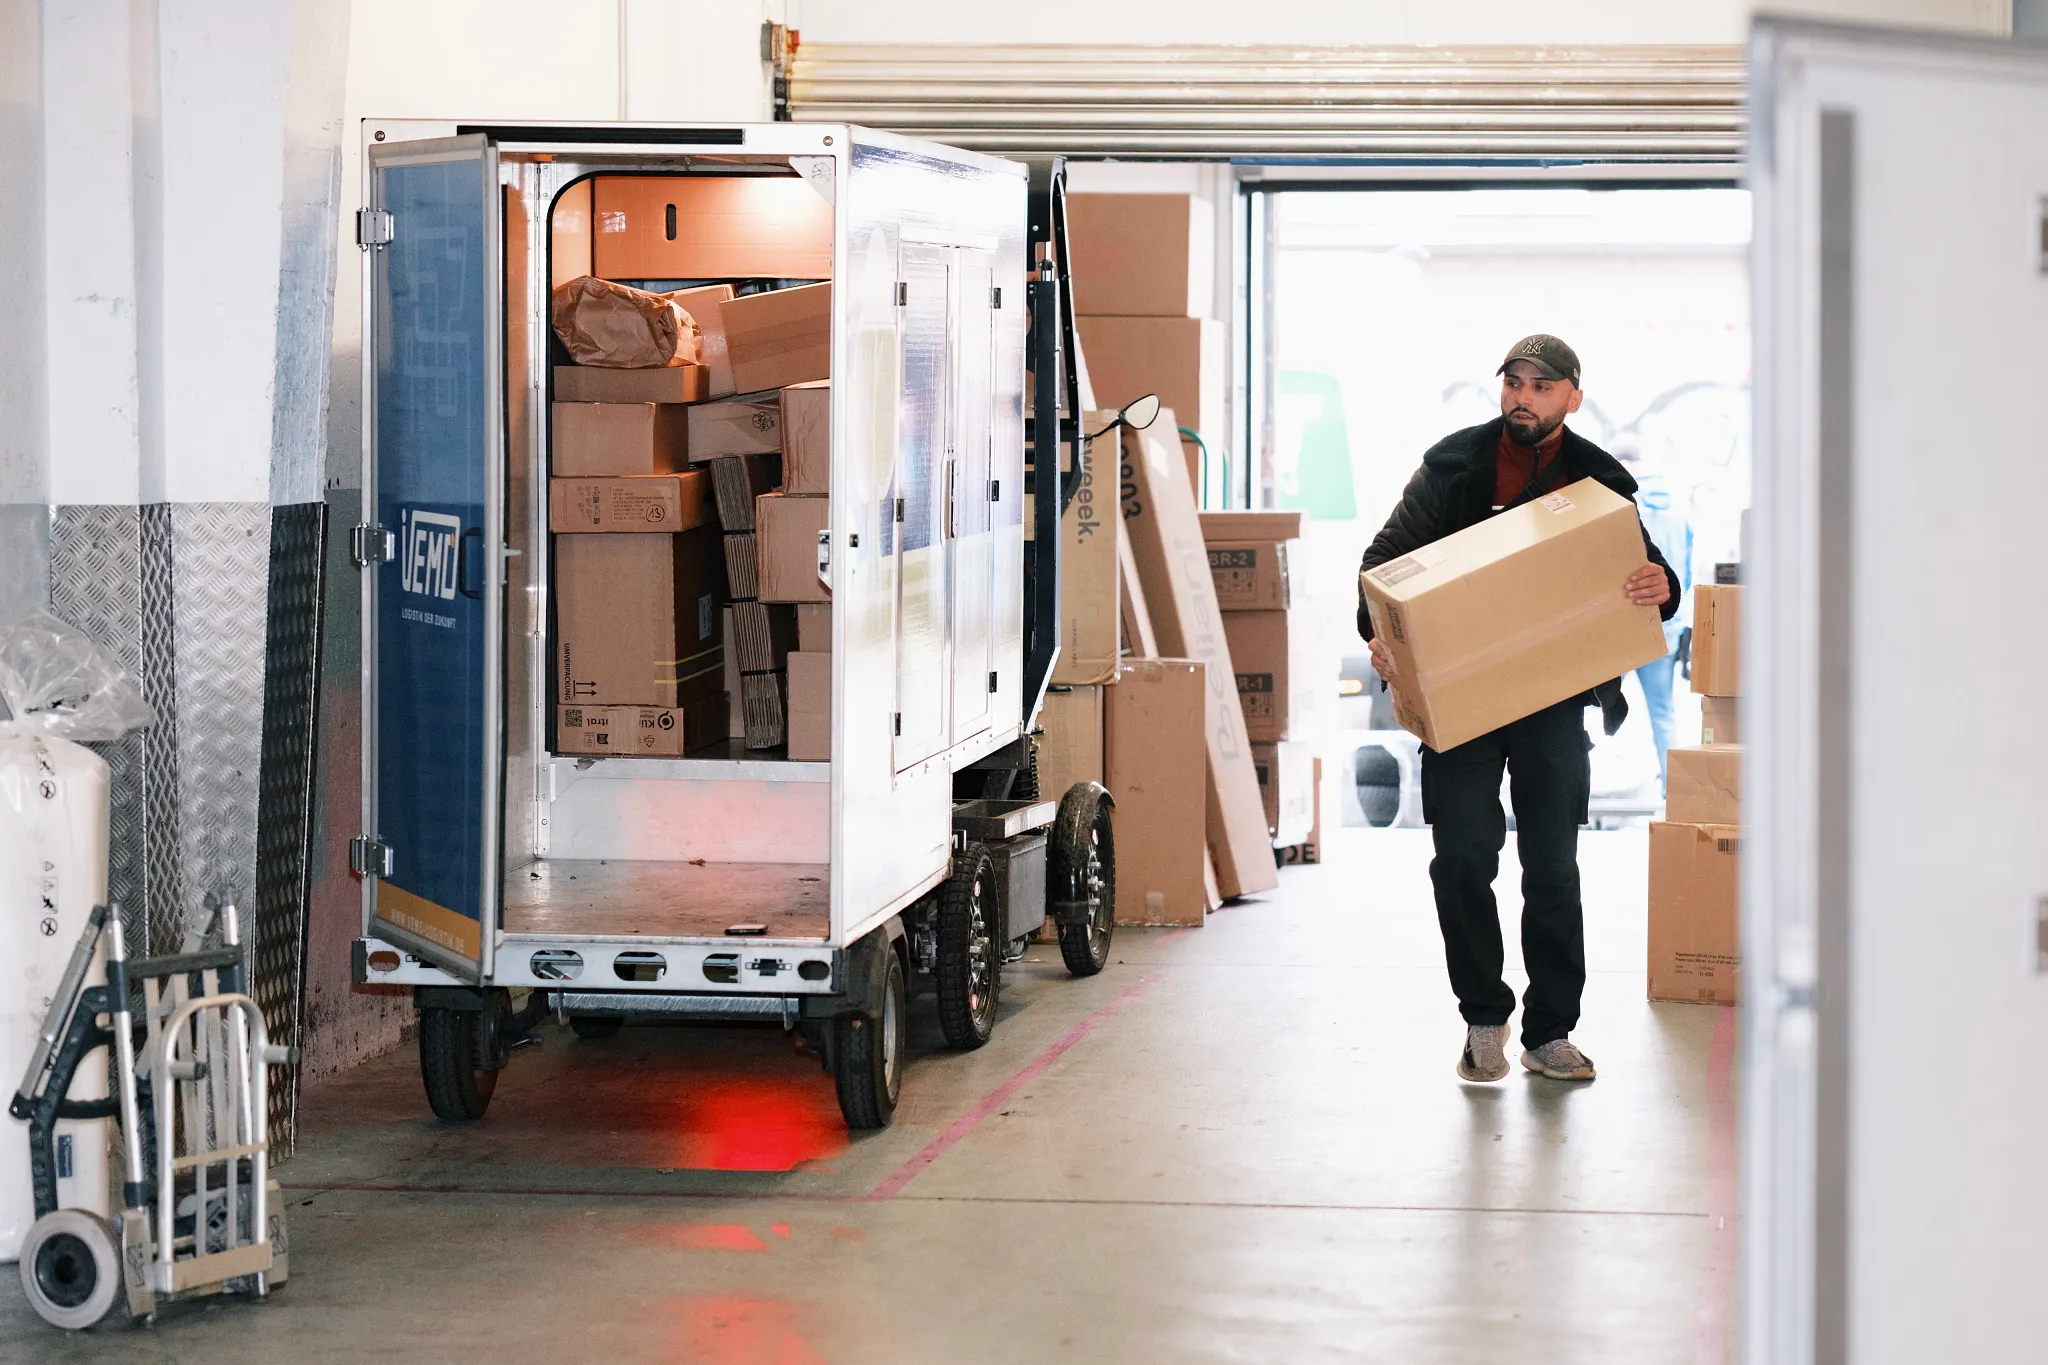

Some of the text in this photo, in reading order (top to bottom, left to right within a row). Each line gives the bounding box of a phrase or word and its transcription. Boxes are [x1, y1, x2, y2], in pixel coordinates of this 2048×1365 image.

[1521, 338, 1545, 355] NY
[1208, 552, 1248, 566] BR-2
[401, 607, 457, 629] LOGISTIK DER ZUKUNFT
[1173, 537, 1241, 762] Beliani
